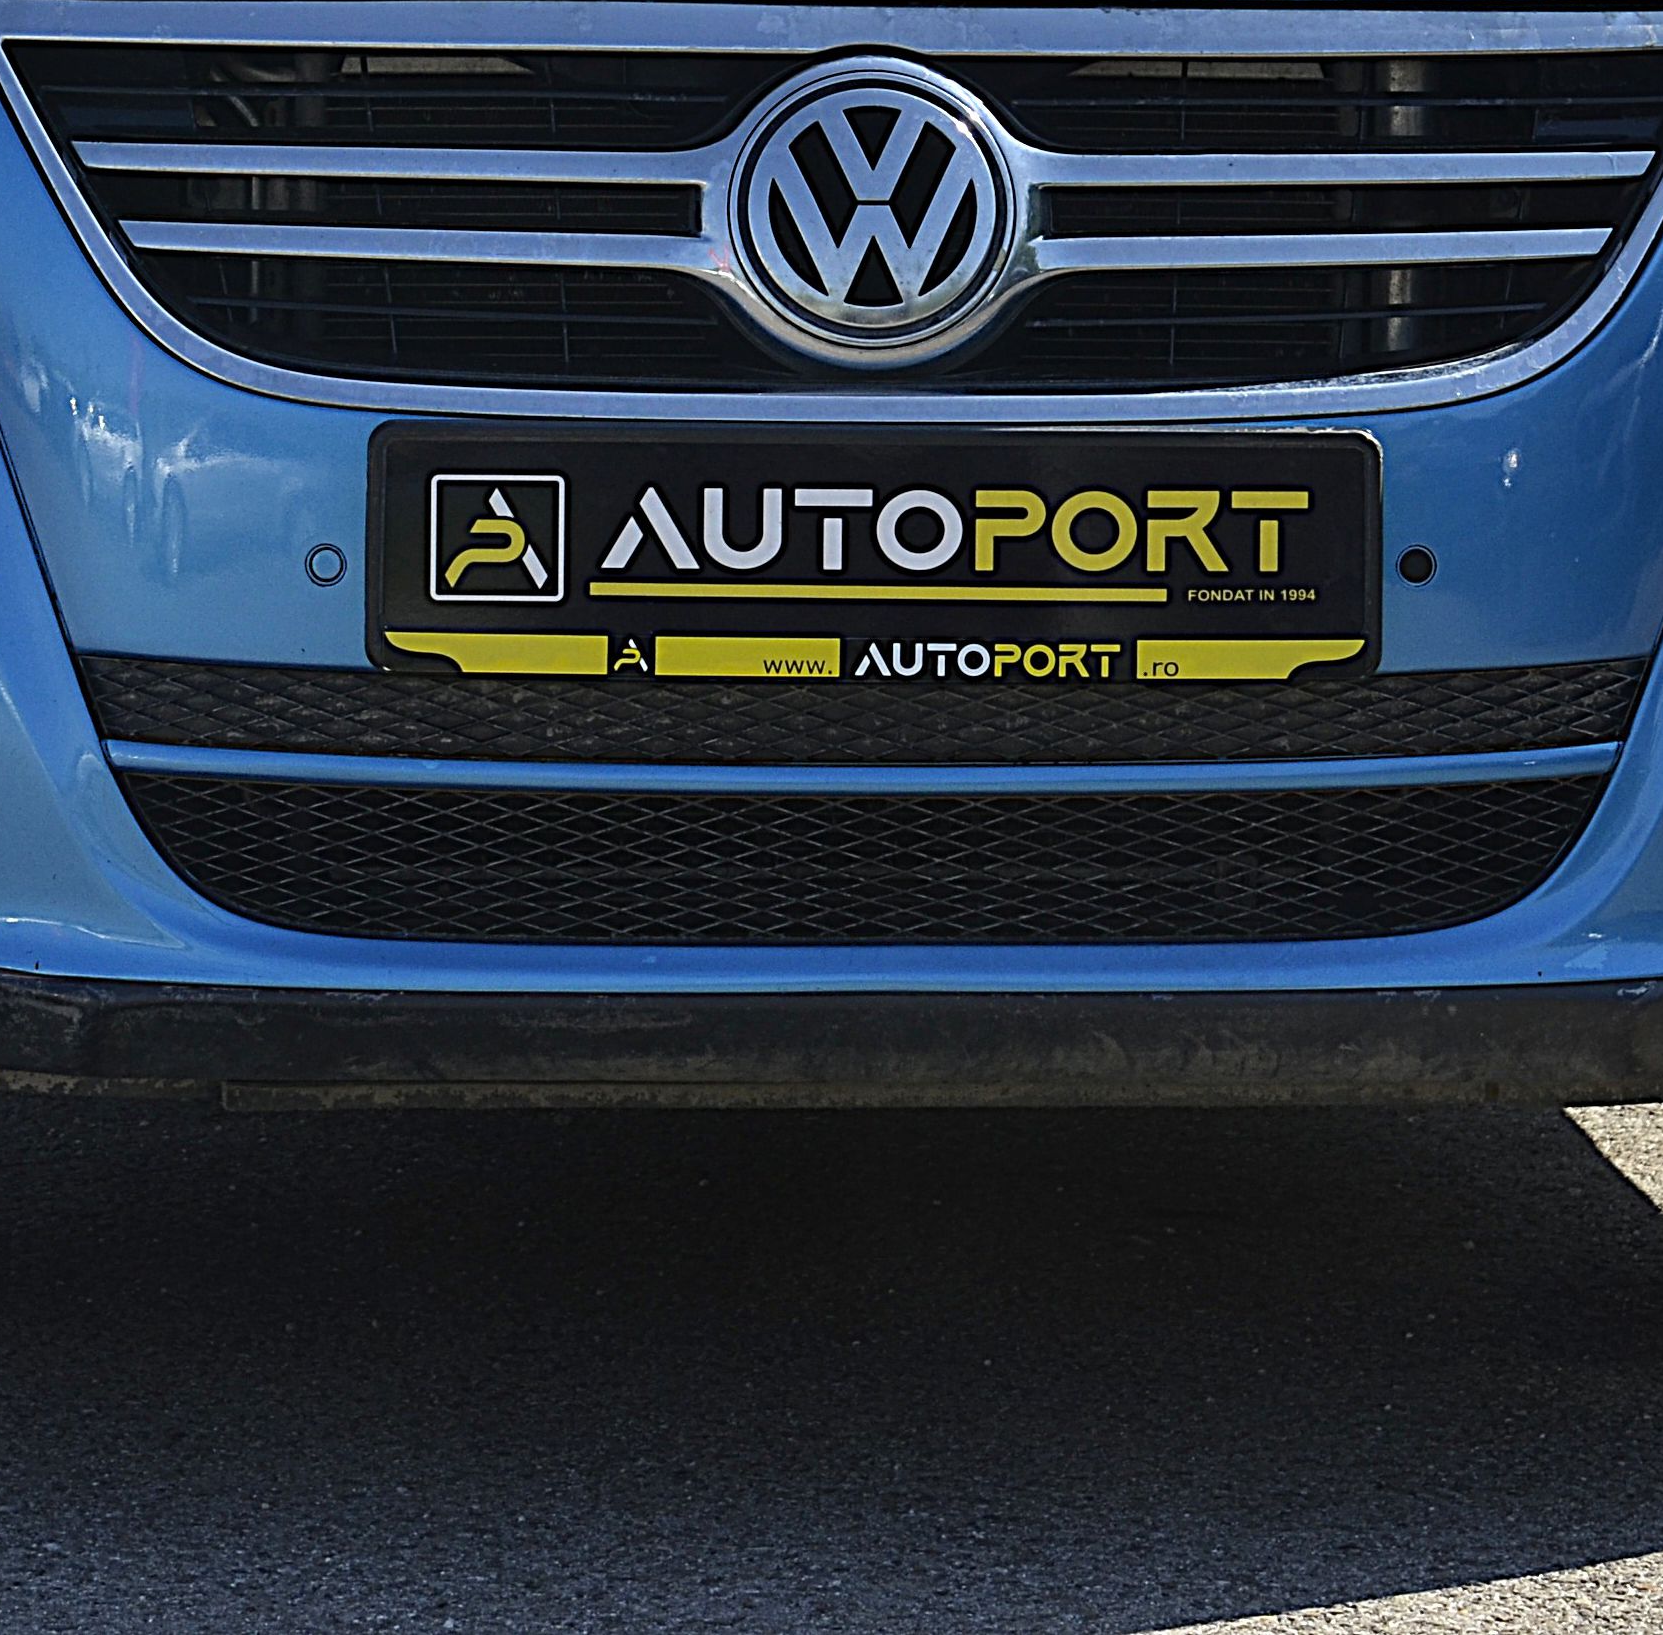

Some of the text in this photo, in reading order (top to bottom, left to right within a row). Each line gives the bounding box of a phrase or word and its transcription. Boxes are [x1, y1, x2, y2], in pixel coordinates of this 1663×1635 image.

[600, 486, 1309, 572] AUTOPORT
[1187, 588, 1317, 602] FONDAT IN 1994
[763, 642, 1179, 678] www. AUTOPORT .ro
